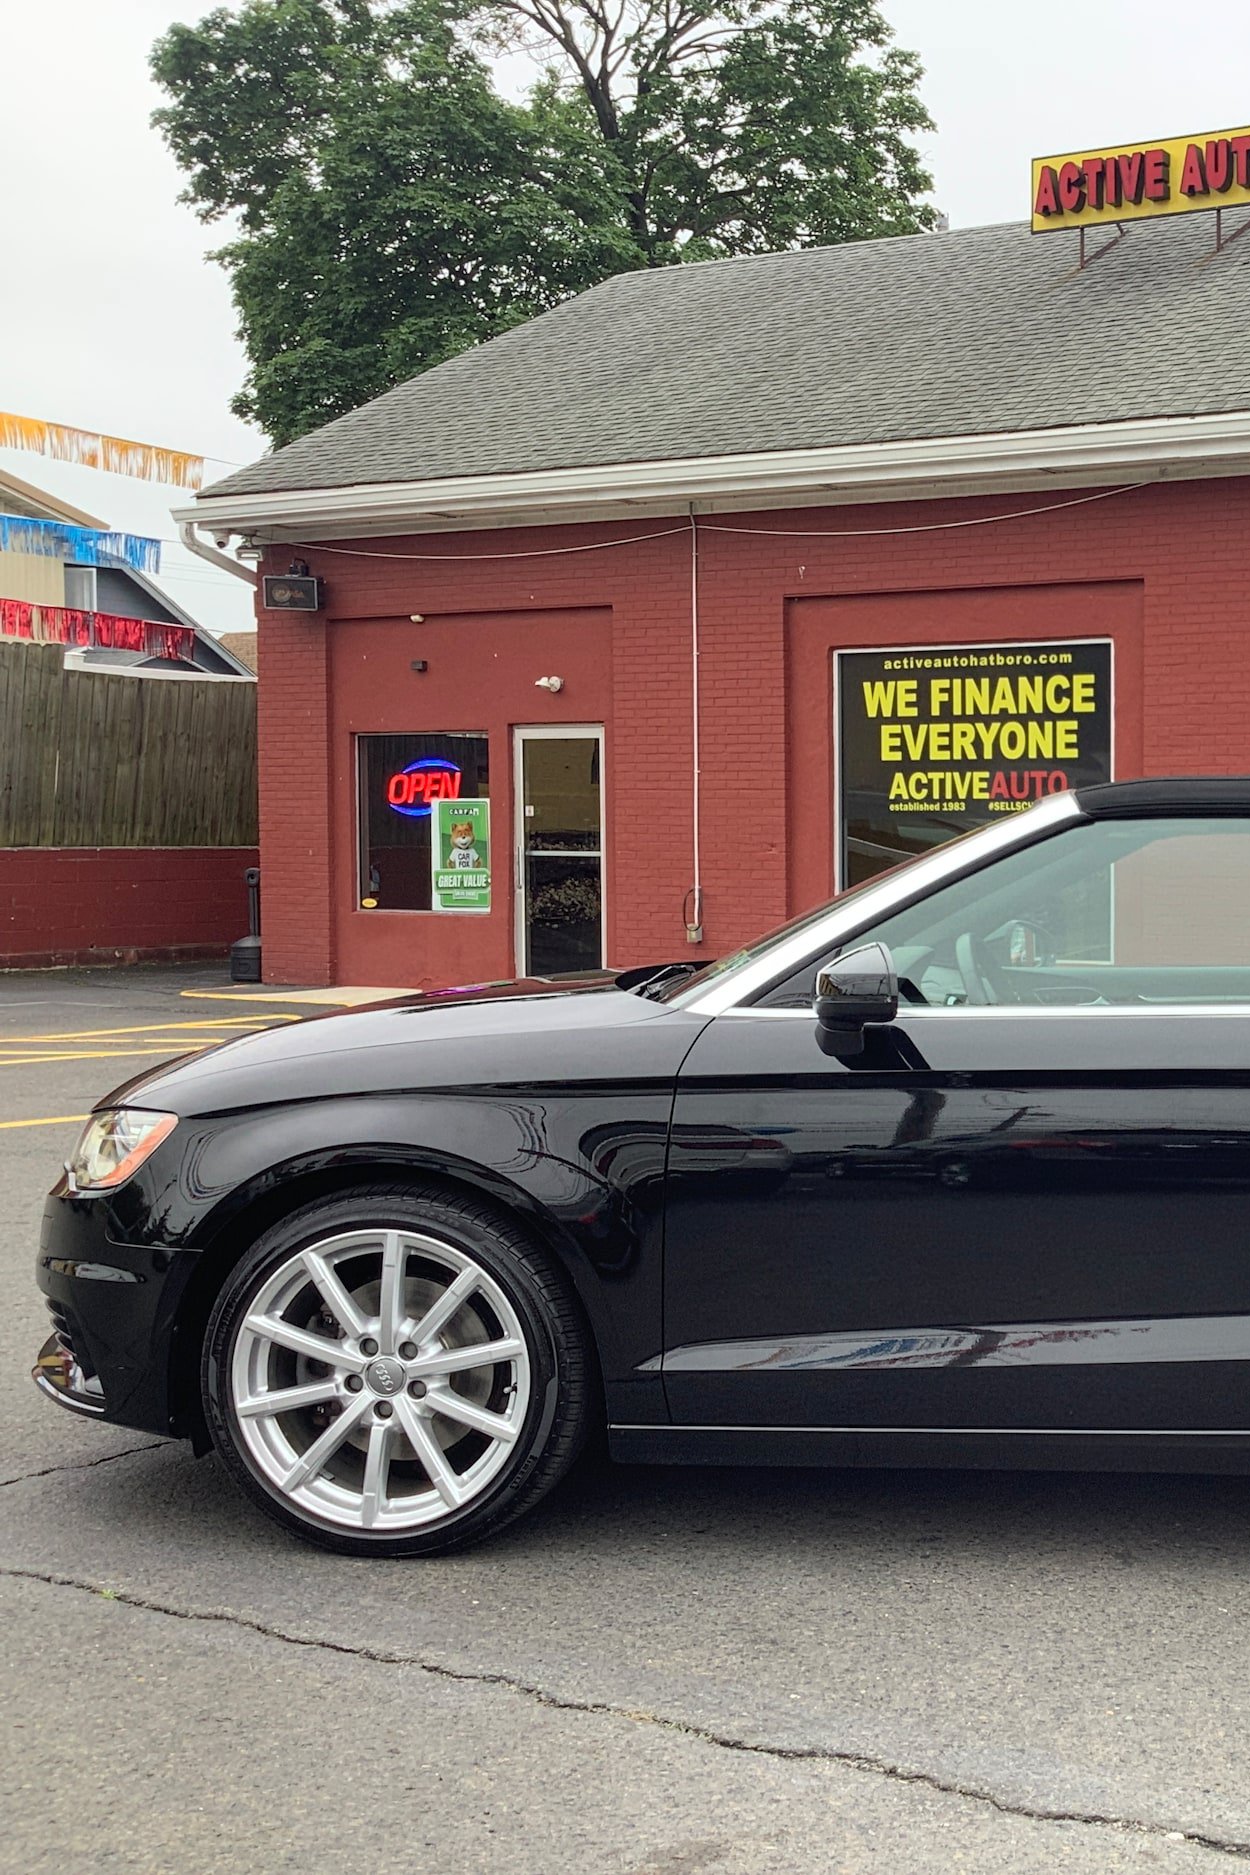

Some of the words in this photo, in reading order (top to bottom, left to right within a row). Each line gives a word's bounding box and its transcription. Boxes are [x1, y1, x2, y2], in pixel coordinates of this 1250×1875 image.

[1035, 149, 1170, 217] ACTIVE
[883, 653, 1073, 670] activeautohatboro.com
[863, 680, 918, 718] WE
[930, 674, 1096, 716] FINANCE
[880, 720, 1079, 762] EVERYONE
[388, 772, 462, 804] OPEN
[889, 802, 940, 811] established
[942, 802, 966, 811] 1983
[458, 853, 470, 861] CAR
[438, 874, 462, 888] GREAT
[463, 874, 488, 888] VALUE
